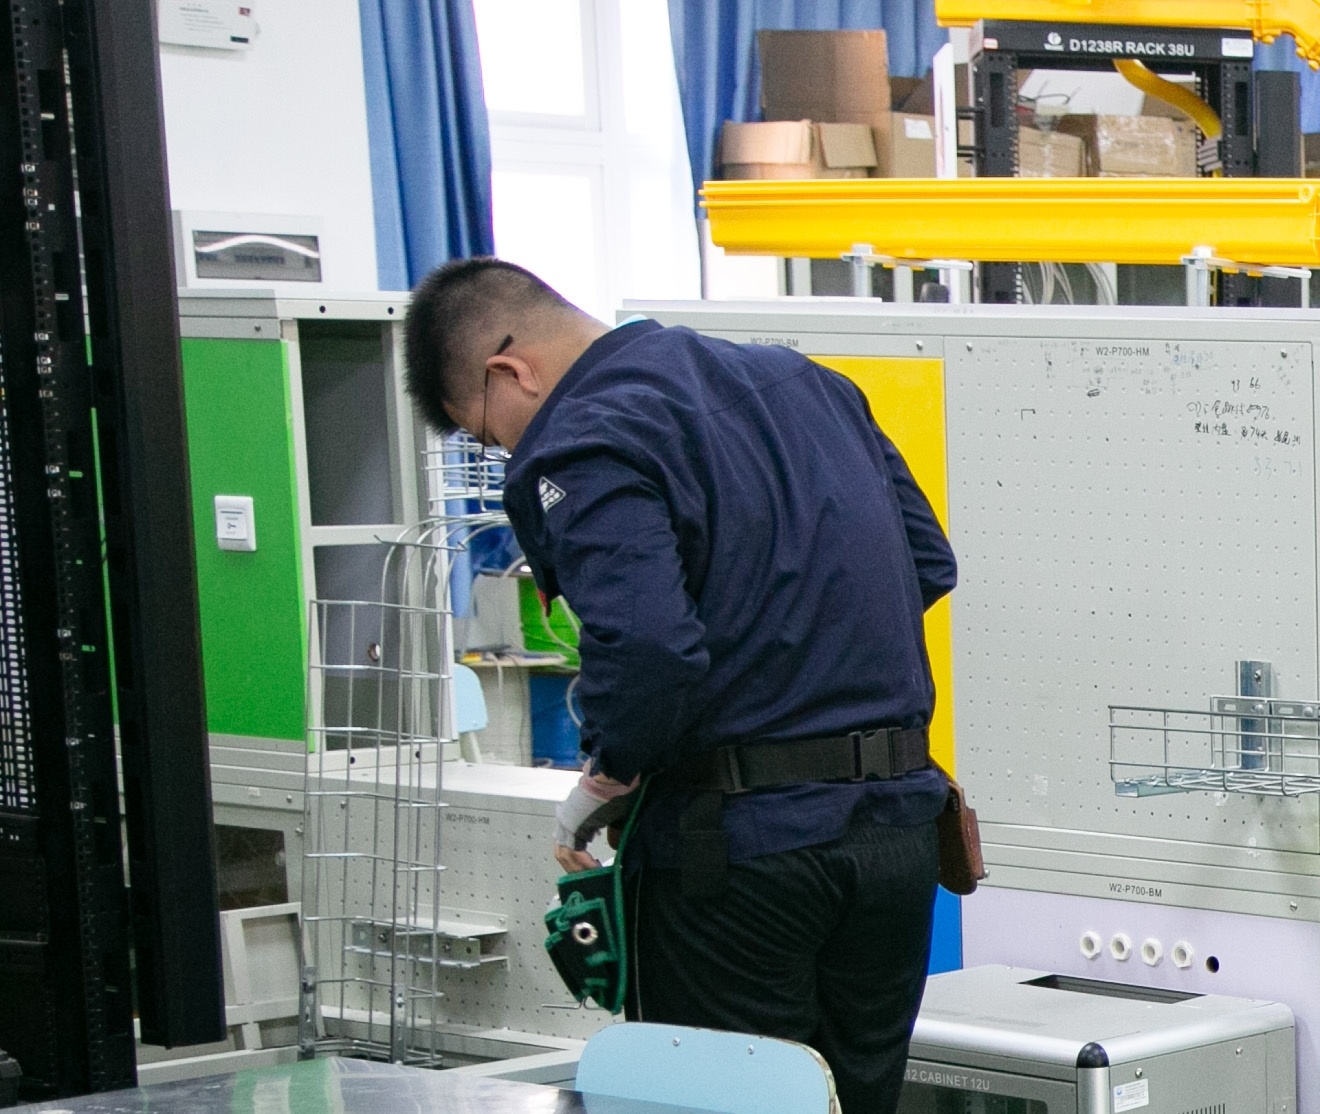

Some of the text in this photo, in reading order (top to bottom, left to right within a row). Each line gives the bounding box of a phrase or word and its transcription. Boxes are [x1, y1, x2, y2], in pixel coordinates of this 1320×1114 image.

[1070, 38, 1123, 53] D1238R
[1126, 41, 1165, 55] RACK
[1168, 42, 1195, 56] 38U
[1095, 346, 1150, 356] W2-P700-HM
[1108, 882, 1163, 898] W2-P700-BM
[919, 1070, 969, 1088] CABINET
[971, 1078, 990, 1091] 12U
